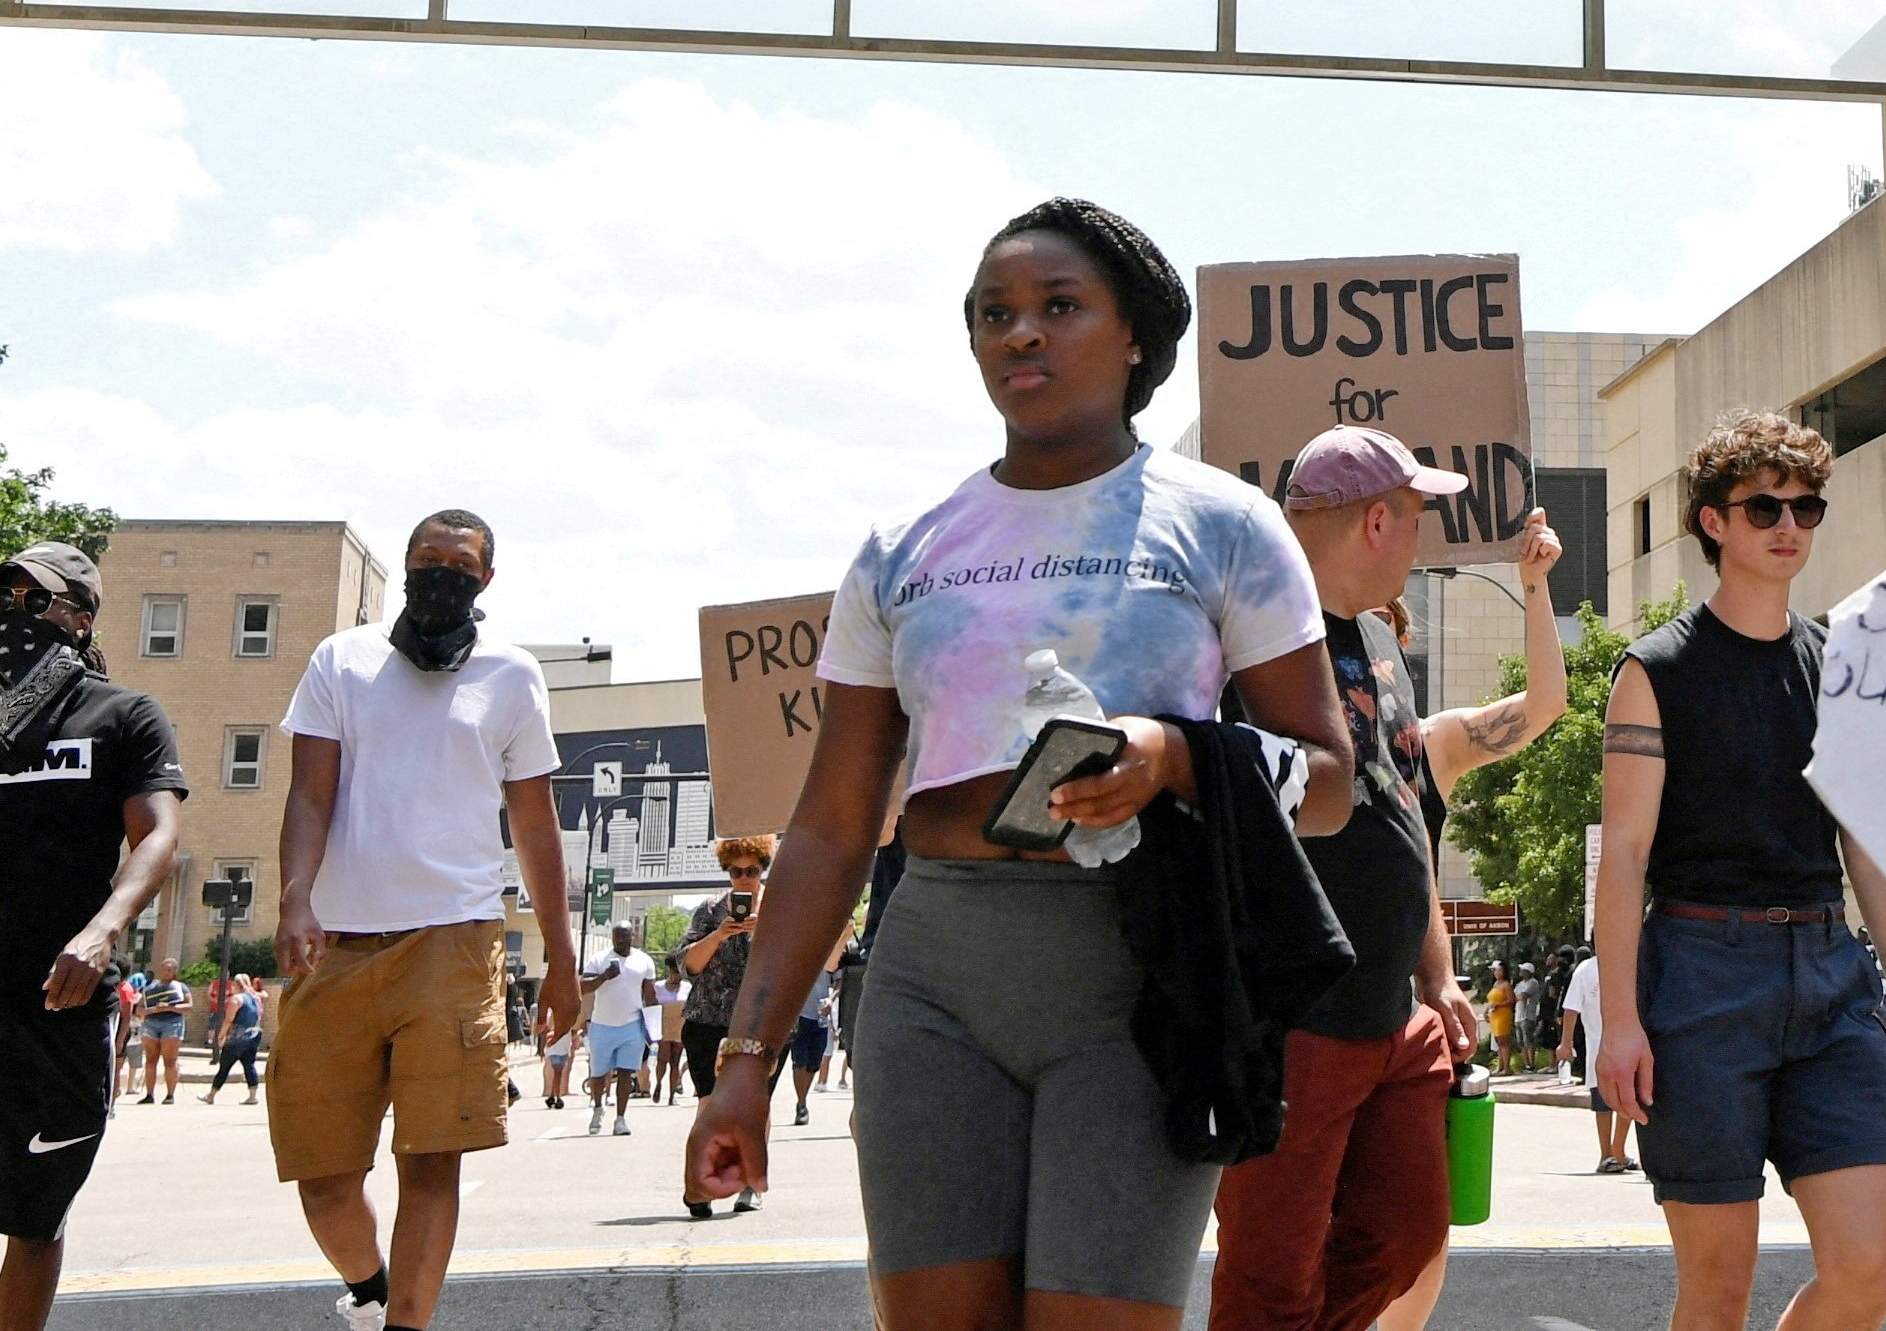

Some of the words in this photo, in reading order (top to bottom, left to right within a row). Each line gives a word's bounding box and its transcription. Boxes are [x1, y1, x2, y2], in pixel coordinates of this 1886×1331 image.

[1218, 273, 1514, 360] JUSTICE
[1328, 377, 1399, 423] for
[938, 557, 1025, 592] social
[1030, 553, 1188, 595] distancing
[725, 613, 830, 683] PRO
